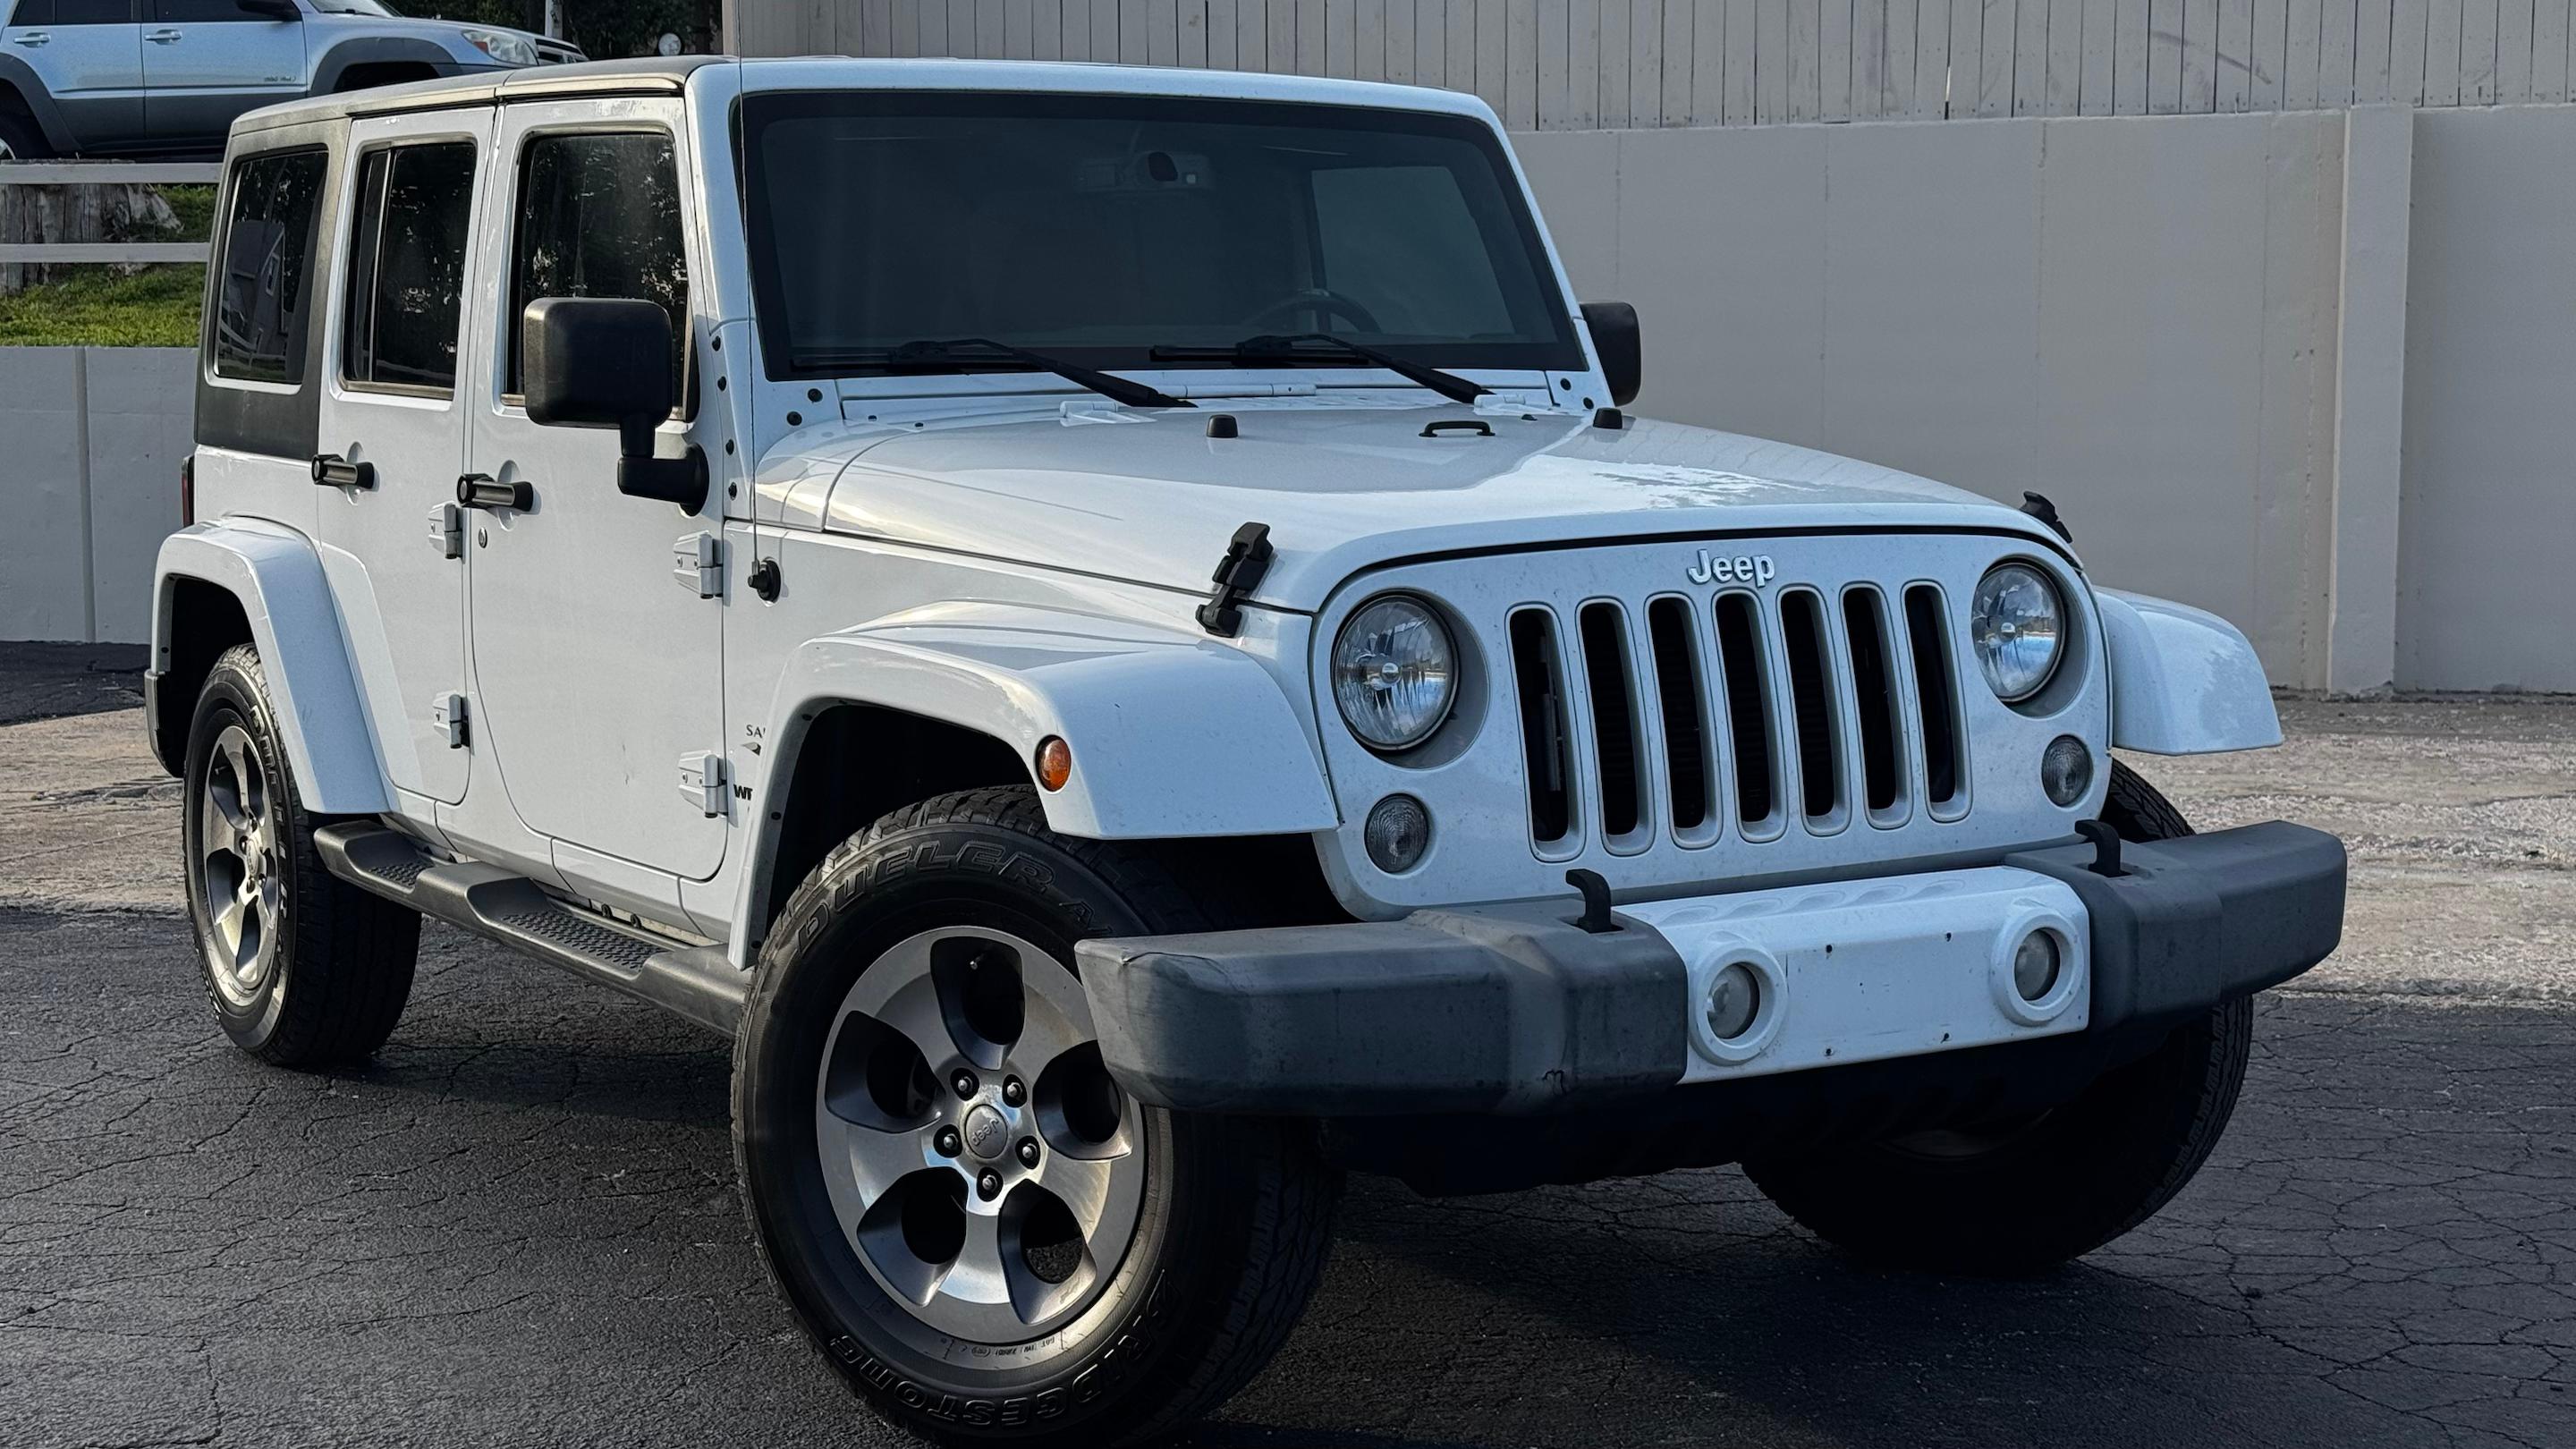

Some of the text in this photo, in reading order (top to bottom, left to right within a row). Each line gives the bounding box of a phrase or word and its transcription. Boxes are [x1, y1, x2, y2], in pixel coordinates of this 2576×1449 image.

[1687, 548, 1775, 588] Jeep
[746, 724, 766, 738] SA
[796, 839, 1058, 957] DUELER
[970, 1118, 1000, 1147] Jeep
[830, 1268, 1177, 1427] BRIDGESTONE
